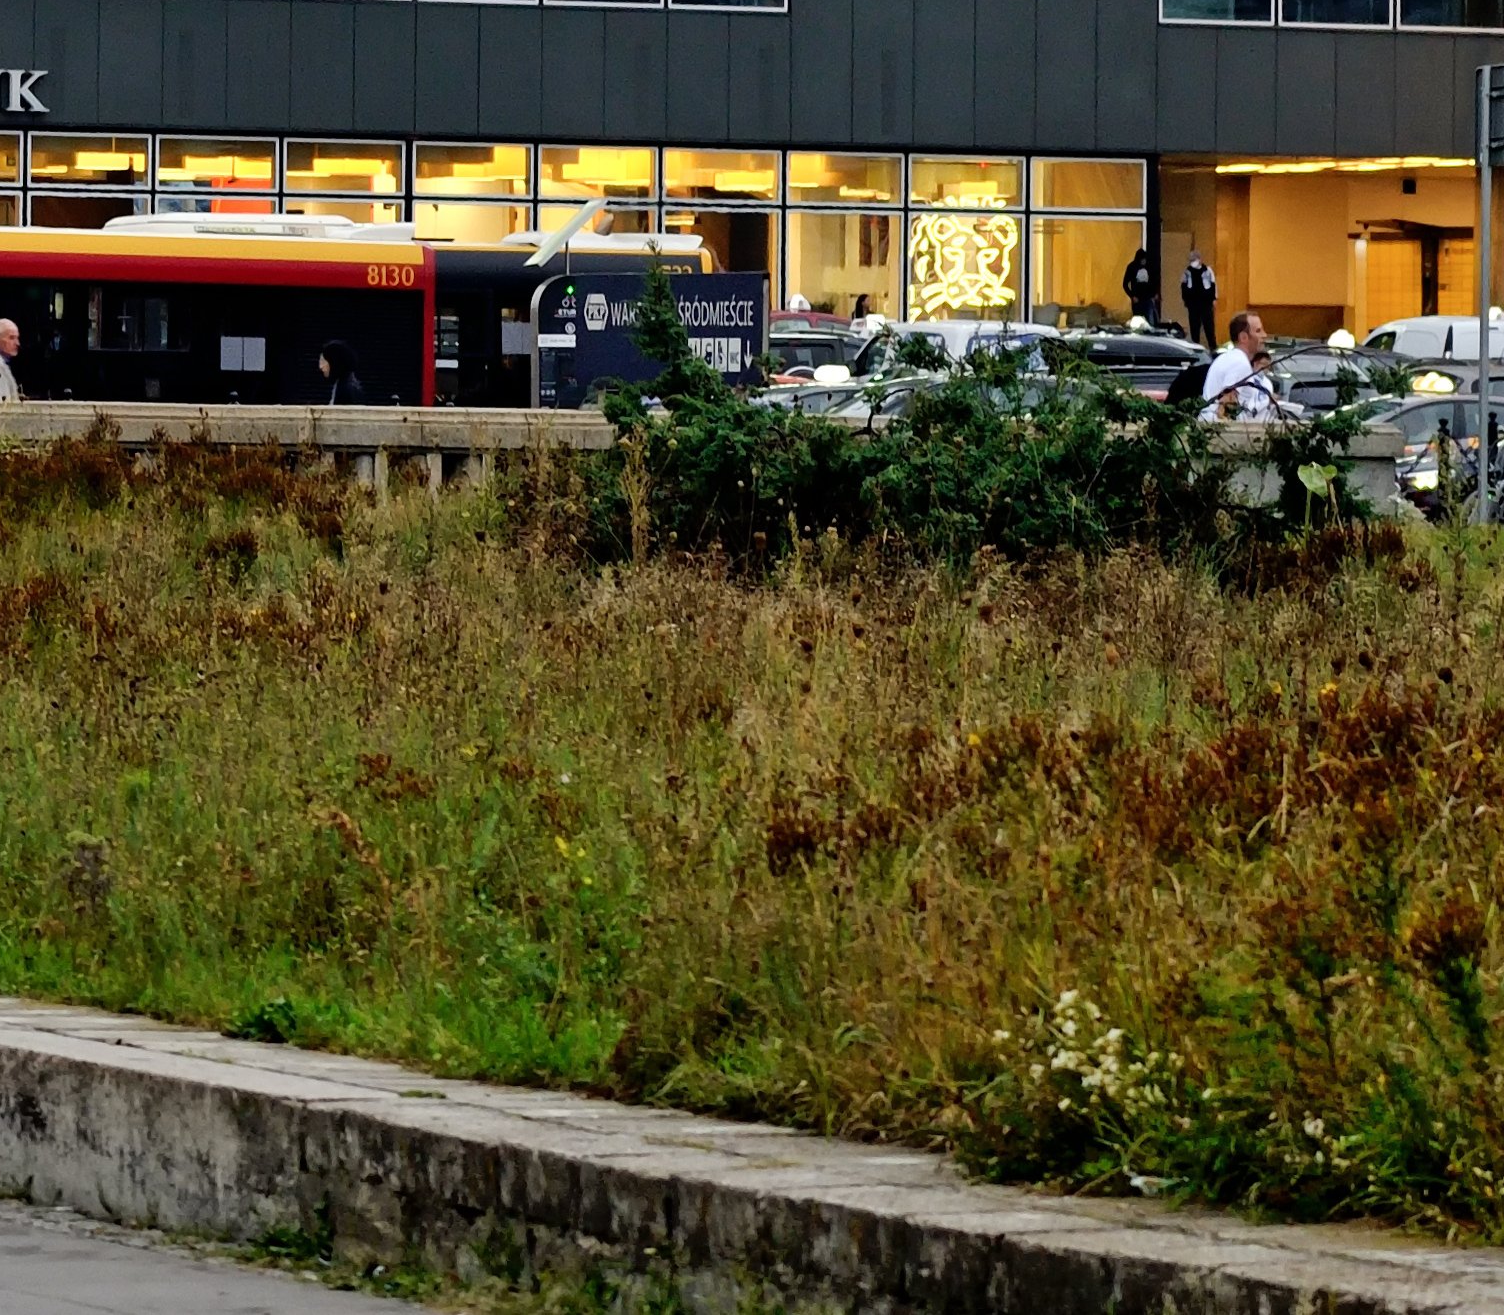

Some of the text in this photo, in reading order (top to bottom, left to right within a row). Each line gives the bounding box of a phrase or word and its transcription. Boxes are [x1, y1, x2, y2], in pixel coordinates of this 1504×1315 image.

[367, 265, 415, 287] 8130
[587, 304, 605, 320] PKP
[678, 295, 754, 327] ŚRÓDMIEŚCIE
